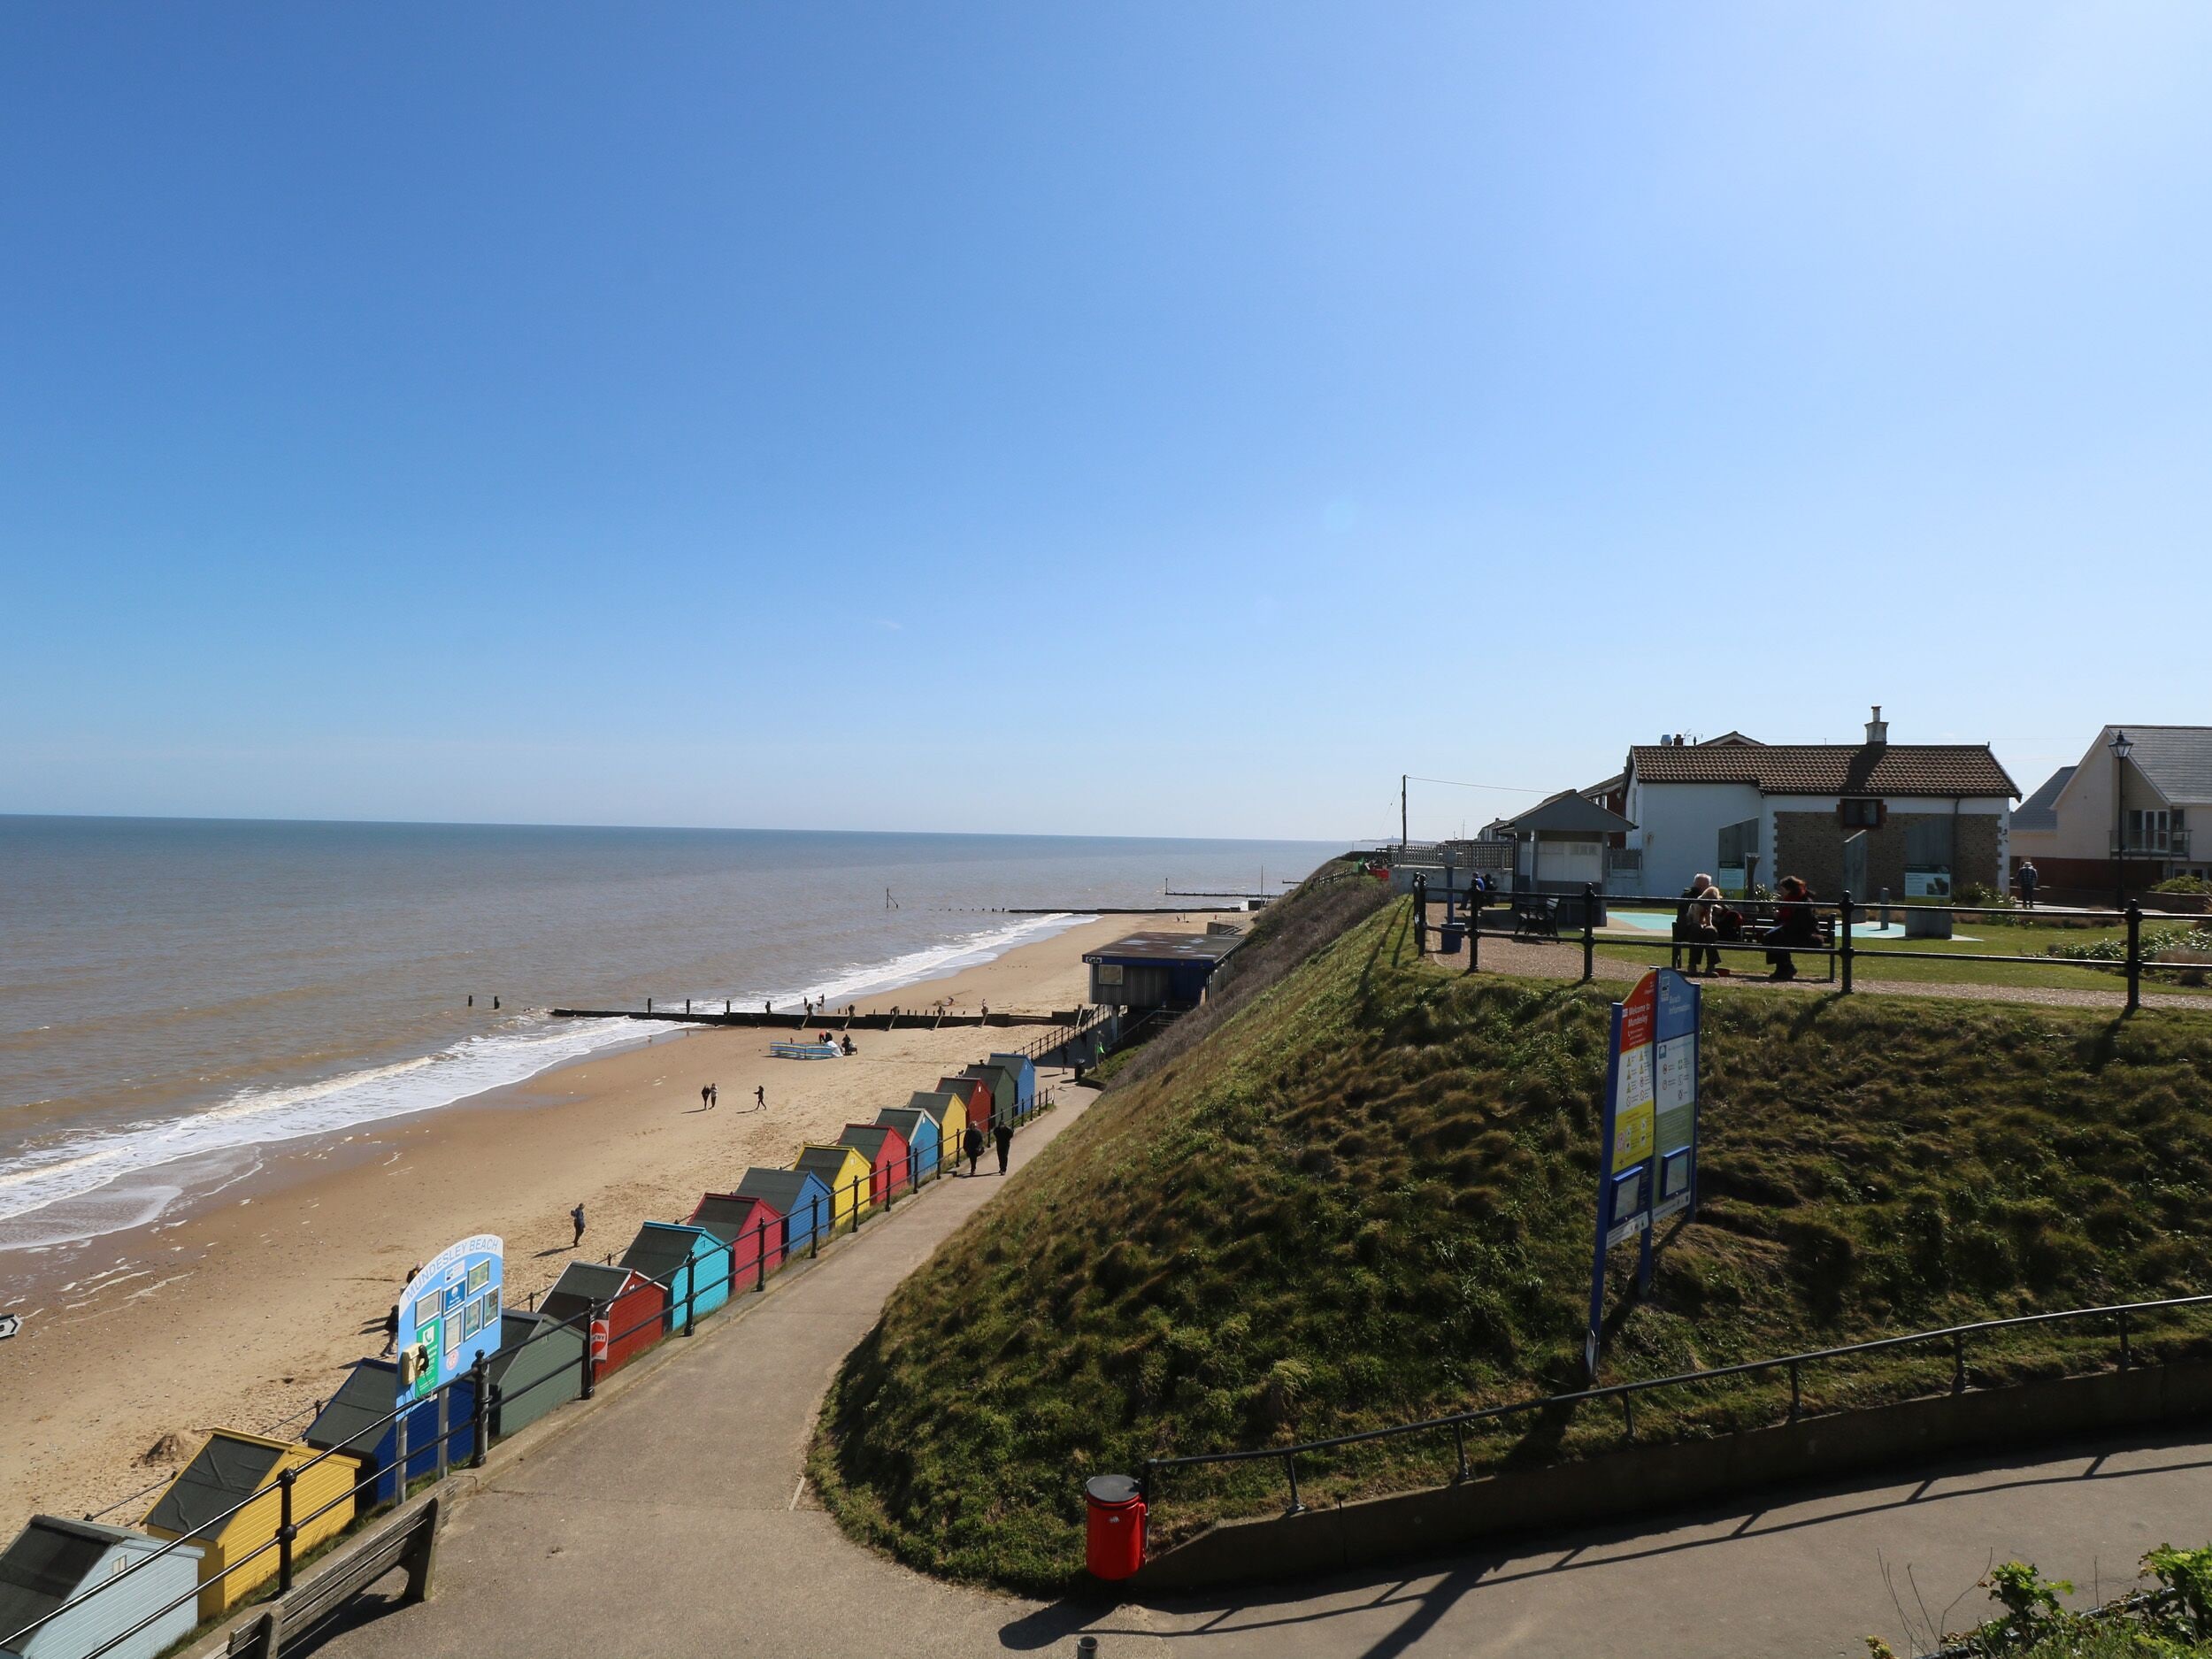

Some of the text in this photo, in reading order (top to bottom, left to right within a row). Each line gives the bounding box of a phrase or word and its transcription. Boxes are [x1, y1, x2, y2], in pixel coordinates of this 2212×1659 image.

[1629, 1004, 1646, 1016] Welcome
[405, 1243, 467, 1301] MUNDESLEY
[470, 1239, 499, 1251] BEACH
